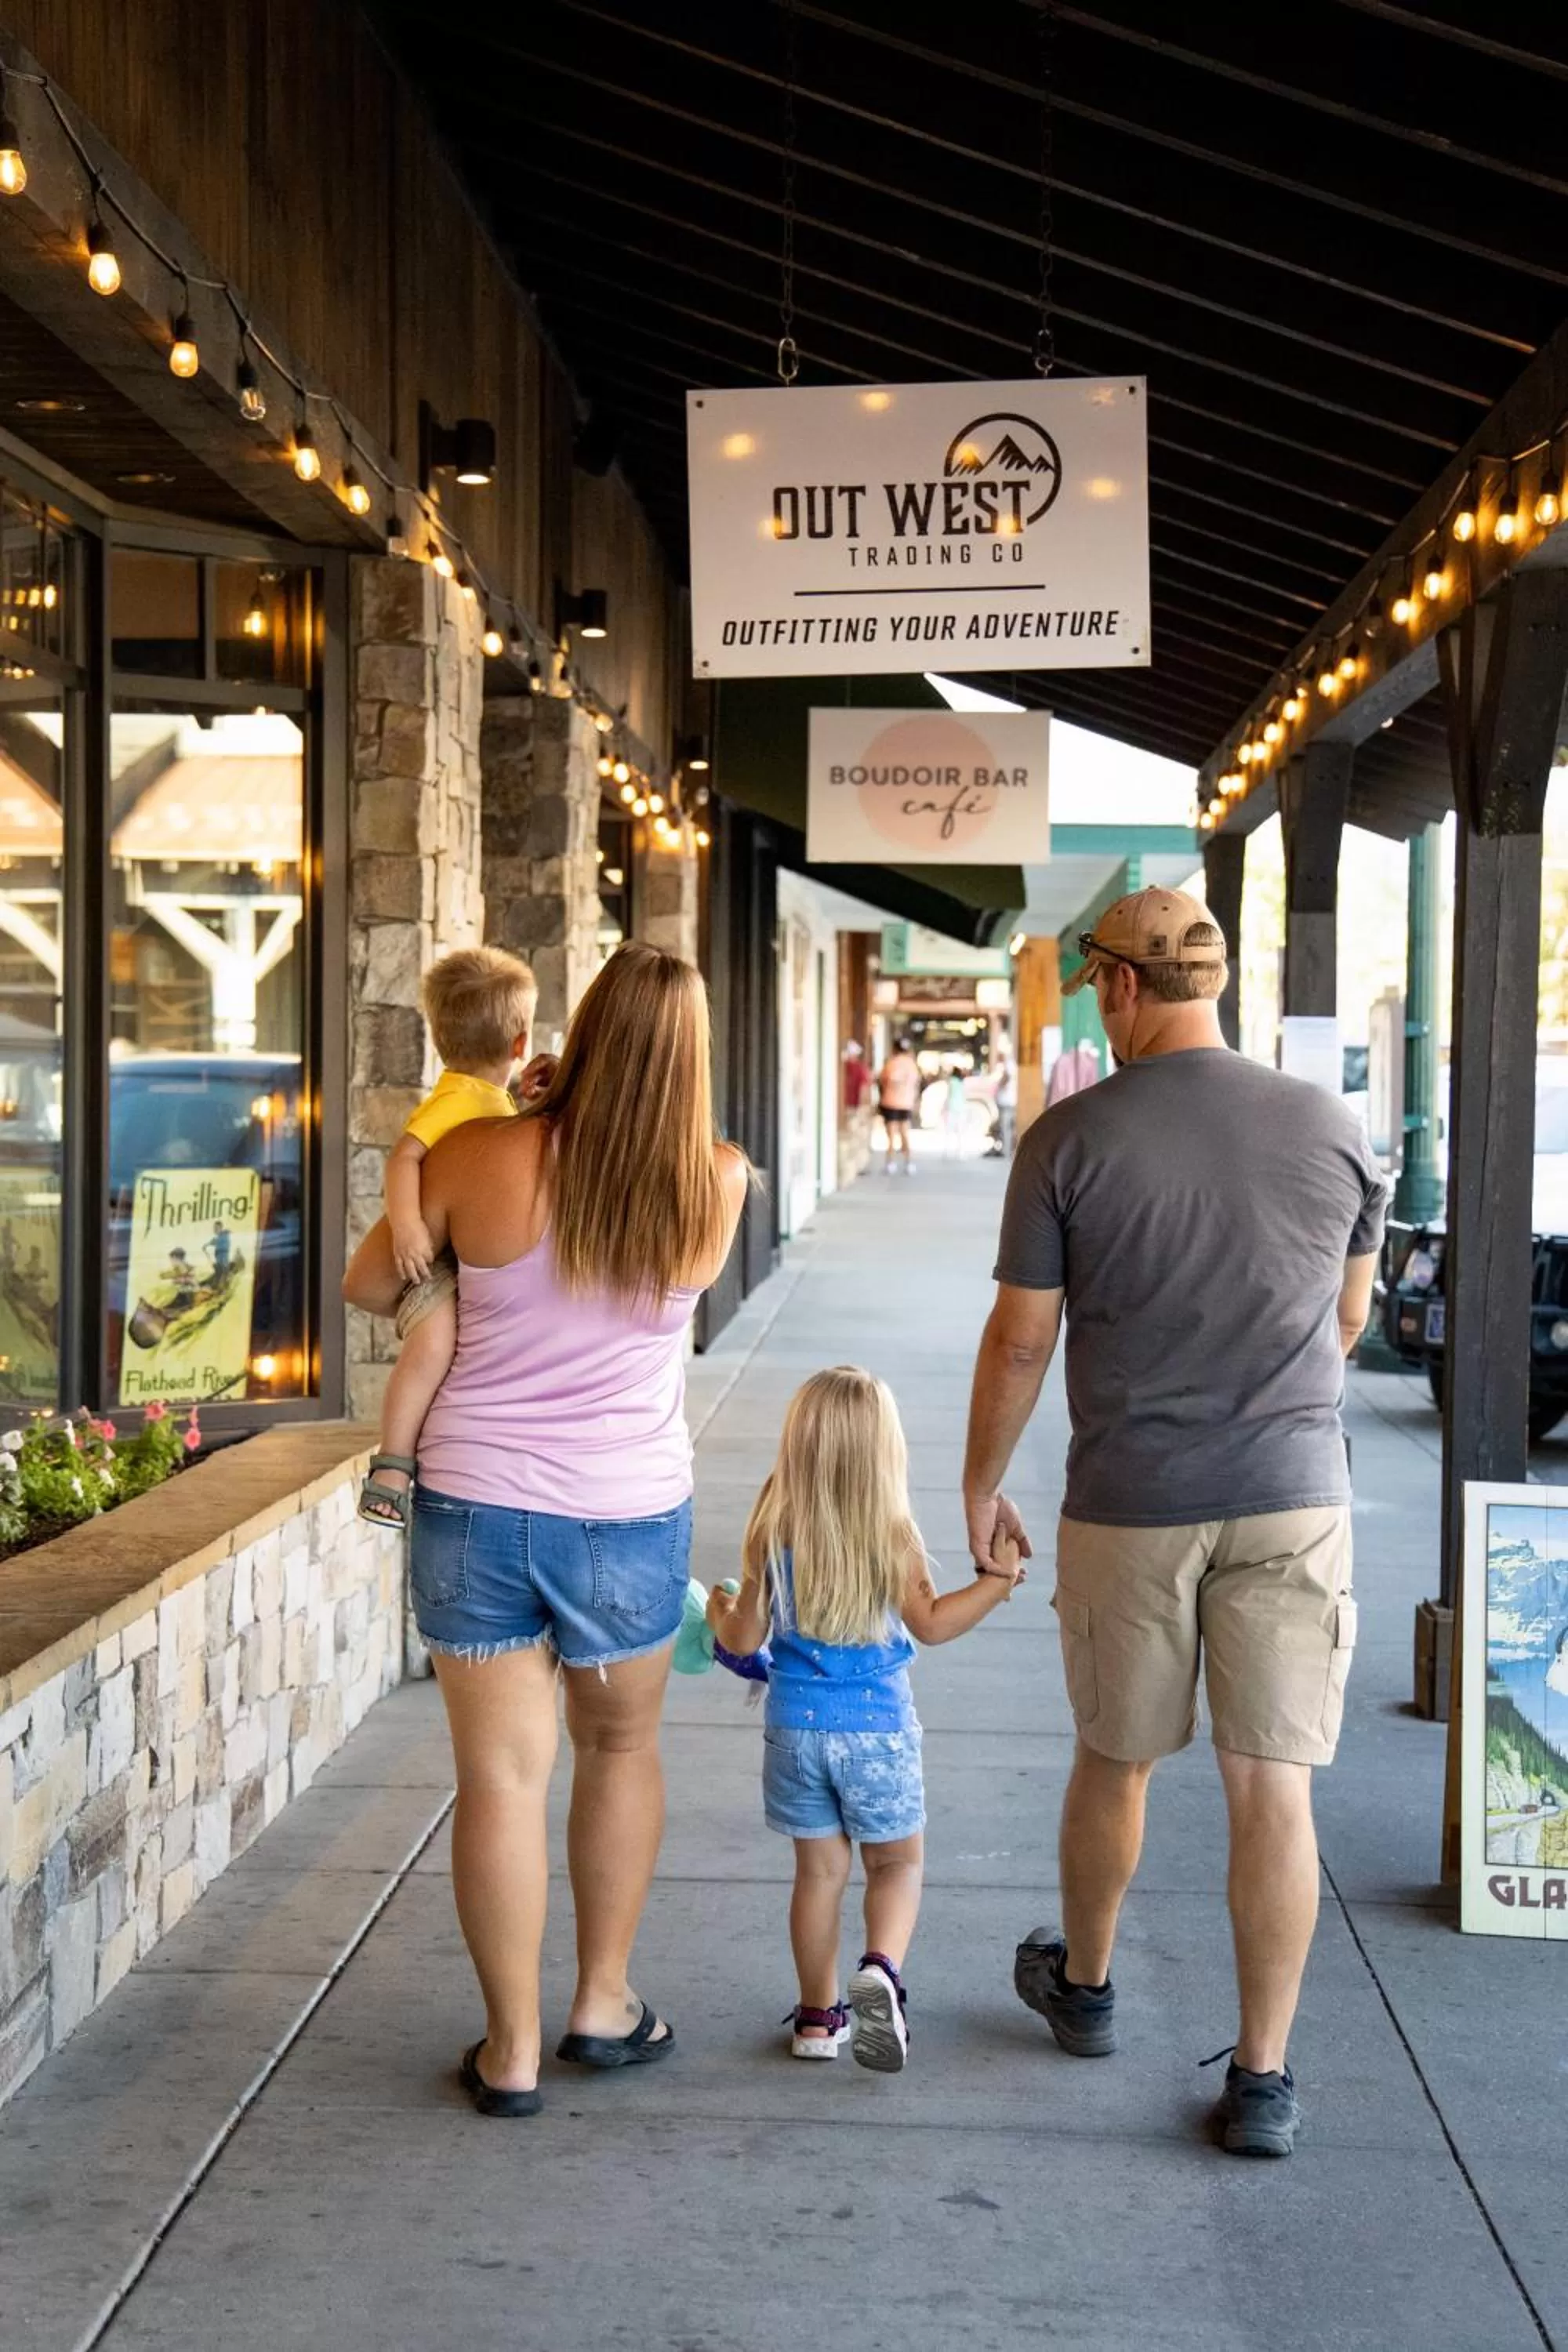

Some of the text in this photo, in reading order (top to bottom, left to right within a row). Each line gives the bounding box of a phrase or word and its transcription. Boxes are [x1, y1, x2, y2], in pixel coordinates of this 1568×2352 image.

[773, 480, 1031, 539] OUT WEST
[848, 543, 1024, 567] TRADING CO
[722, 610, 1120, 645] OUTFITTING YOUR ADVENTURE
[829, 764, 1029, 788] BOUDOIR BAR
[140, 1174, 256, 1240] Thrilling!
